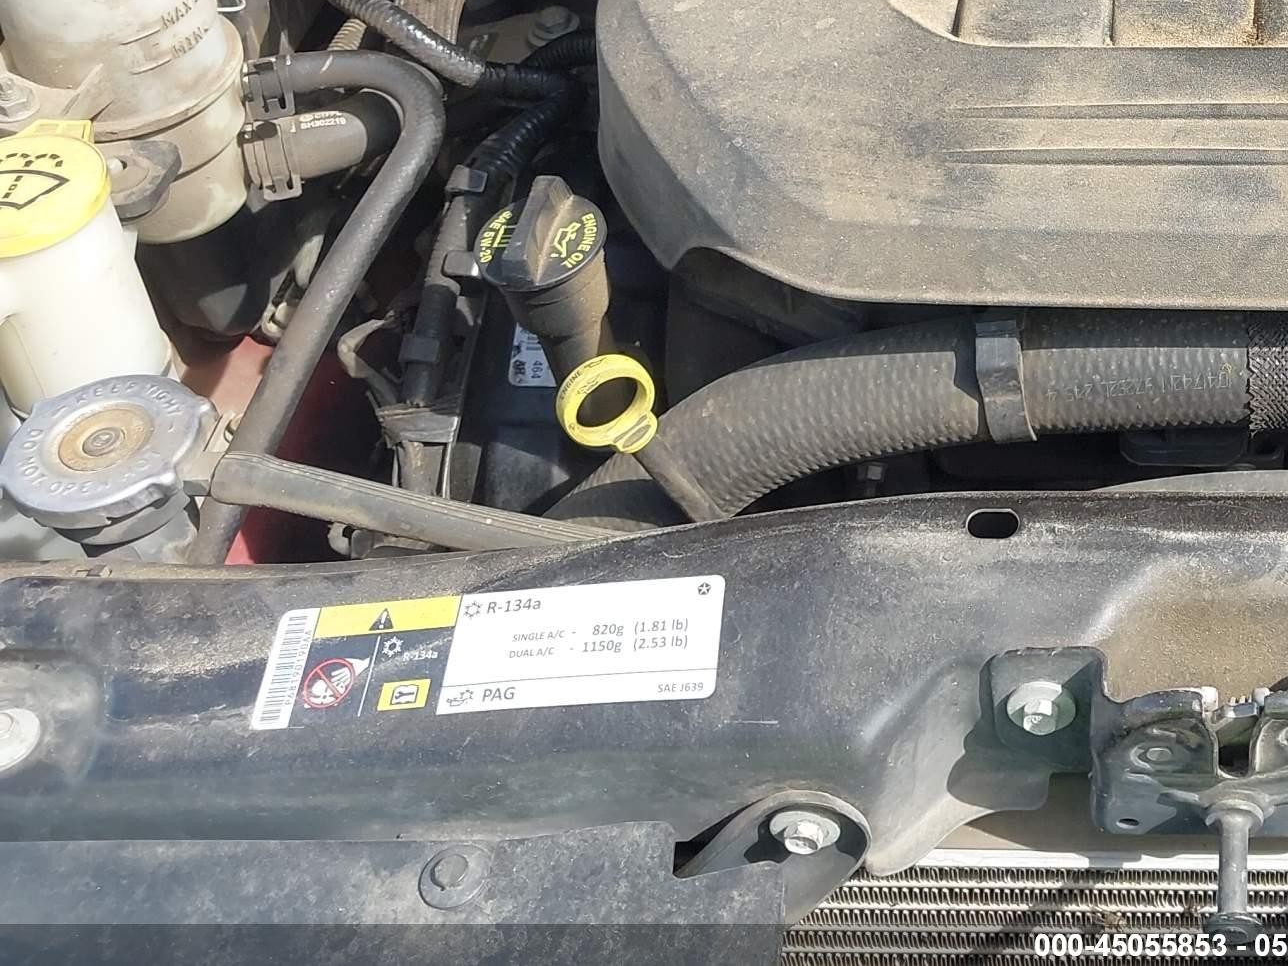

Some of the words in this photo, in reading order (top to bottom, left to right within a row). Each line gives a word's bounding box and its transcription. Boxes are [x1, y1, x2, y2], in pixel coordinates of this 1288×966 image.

[489, 210, 513, 230] SAE
[577, 213, 598, 252] ENGINE
[561, 252, 584, 269] OIL
[487, 597, 541, 614] R-134a
[512, 632, 547, 643] SINGLE
[548, 629, 566, 640] A/C
[592, 622, 624, 638] 820g
[634, 620, 666, 636] (1.81
[671, 619, 689, 635] lb)
[509, 648, 534, 659] DUAL
[534, 645, 555, 657] A/C
[582, 639, 622, 655] 1150g
[633, 637, 666, 652] (2.53
[670, 635, 689, 650] lb)
[403, 650, 439, 663] R-134a
[482, 687, 515, 702] PAG
[657, 684, 677, 694] SAE
[679, 682, 704, 693] J639
